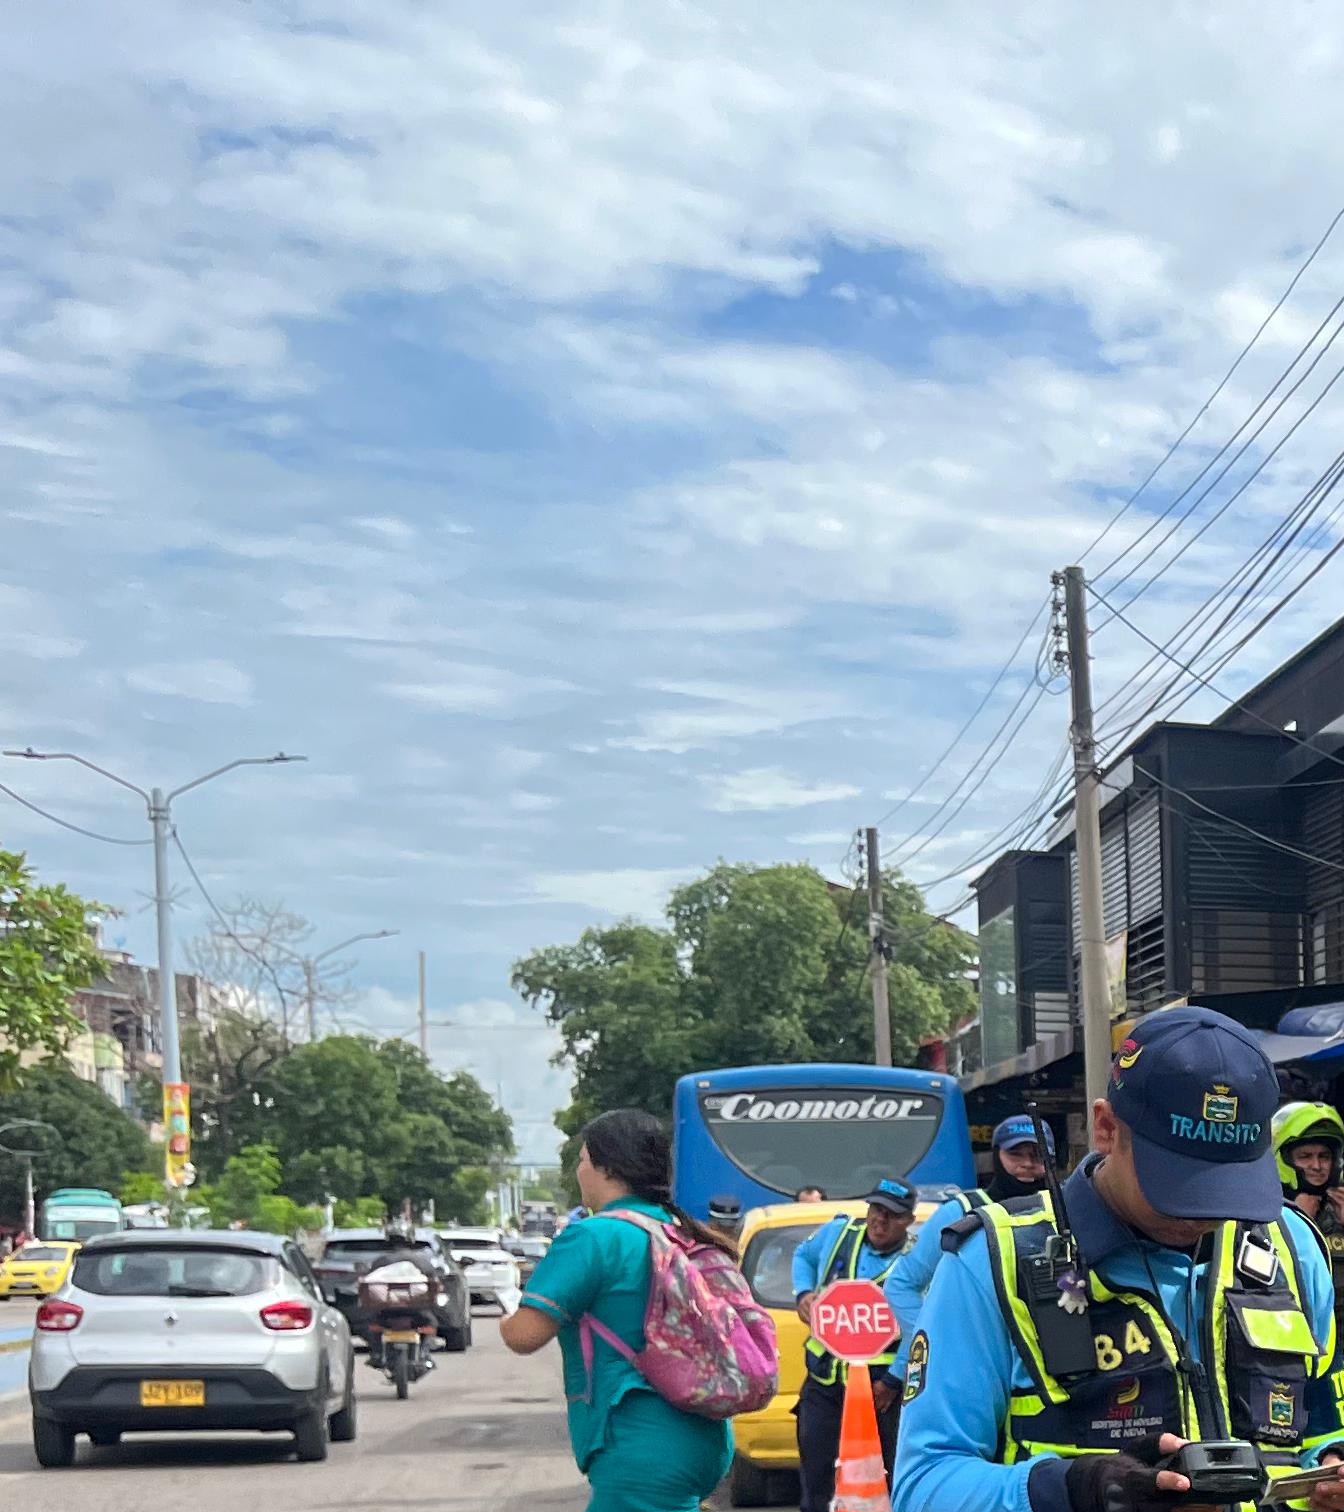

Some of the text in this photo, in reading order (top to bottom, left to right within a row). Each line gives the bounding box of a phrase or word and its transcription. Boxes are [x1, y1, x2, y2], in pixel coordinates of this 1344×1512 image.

[720, 1093, 924, 1121] Coomotor
[1170, 1112, 1261, 1145] TRANSITO
[818, 1303, 892, 1336] PARE
[1094, 1319, 1151, 1371] 84
